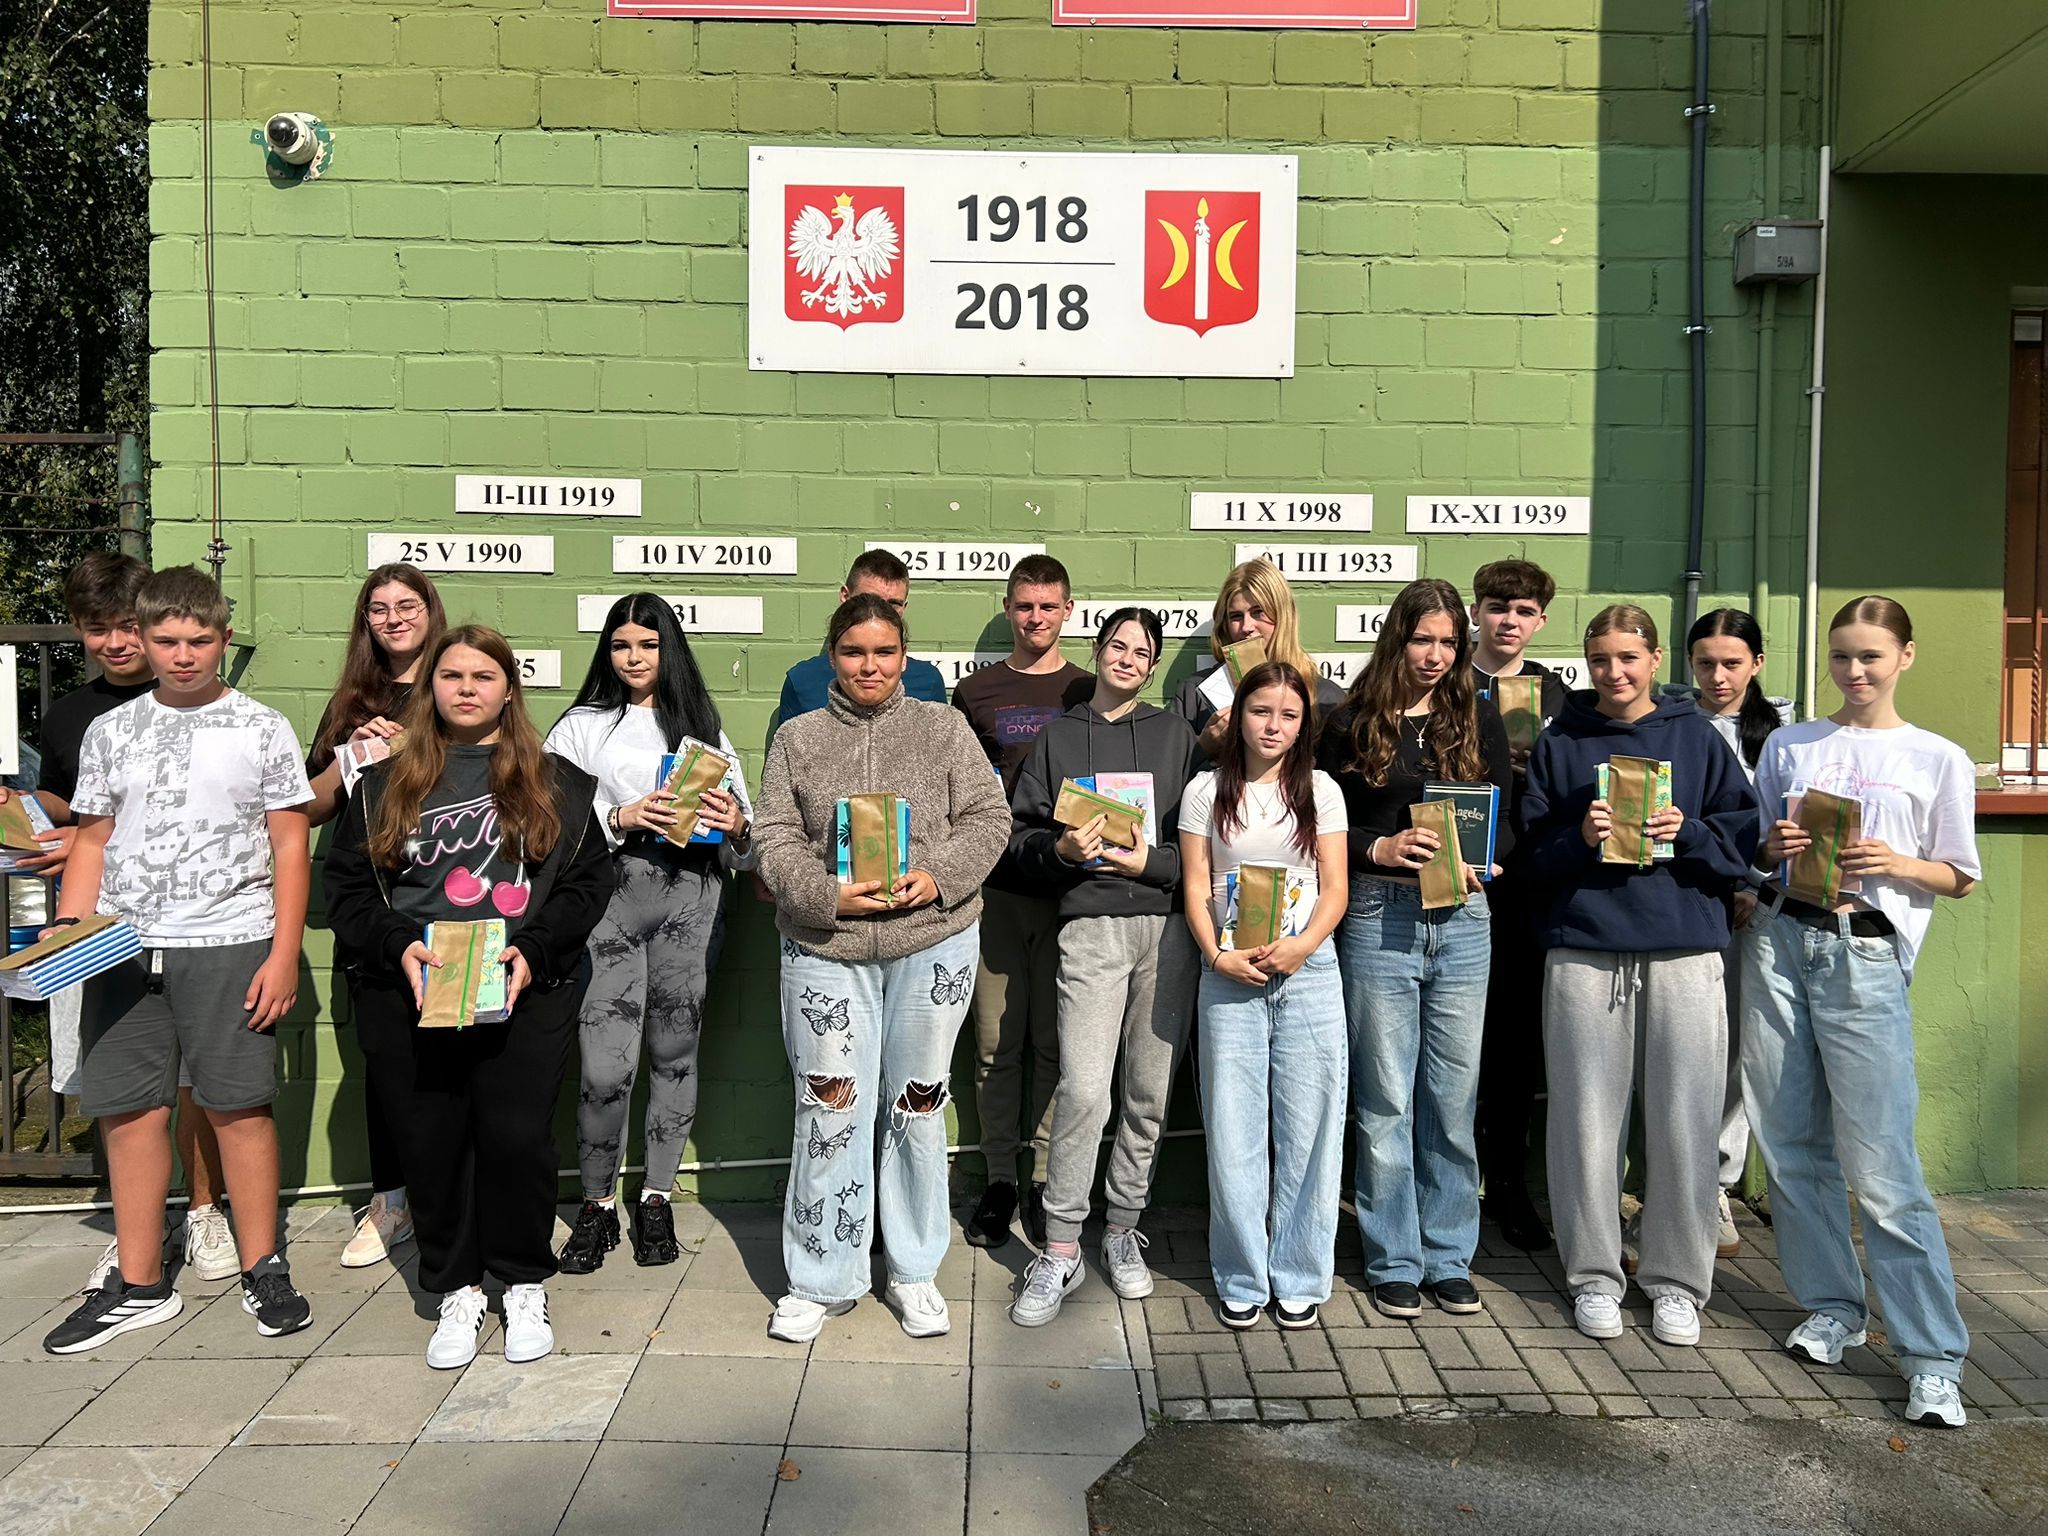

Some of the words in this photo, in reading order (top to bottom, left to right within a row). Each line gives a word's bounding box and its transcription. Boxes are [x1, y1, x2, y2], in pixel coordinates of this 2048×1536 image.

[958, 194, 1088, 244] 1918
[955, 282, 1089, 331] 2018
[483, 484, 549, 506] II-III
[559, 486, 615, 507] 1919
[1224, 501, 1246, 521] 11
[1256, 501, 1278, 522] X
[1287, 502, 1342, 523] 1998
[1430, 503, 1502, 524] IX-XI
[1513, 504, 1568, 525] 1939
[400, 541, 428, 563] 25
[436, 542, 457, 562] V
[466, 543, 522, 564] 1990
[641, 544, 667, 565] 10
[677, 544, 707, 565] IV
[715, 545, 772, 566] 2010
[901, 550, 928, 571] 25
[936, 551, 946, 571] I
[957, 551, 1011, 572] 1920
[1296, 552, 1328, 572] III
[1338, 552, 1393, 573] 1933
[1081, 608, 1106, 629] 16
[1156, 608, 1199, 629] 978
[1358, 612, 1385, 634] 16
[1455, 807, 1486, 822] ngeles
